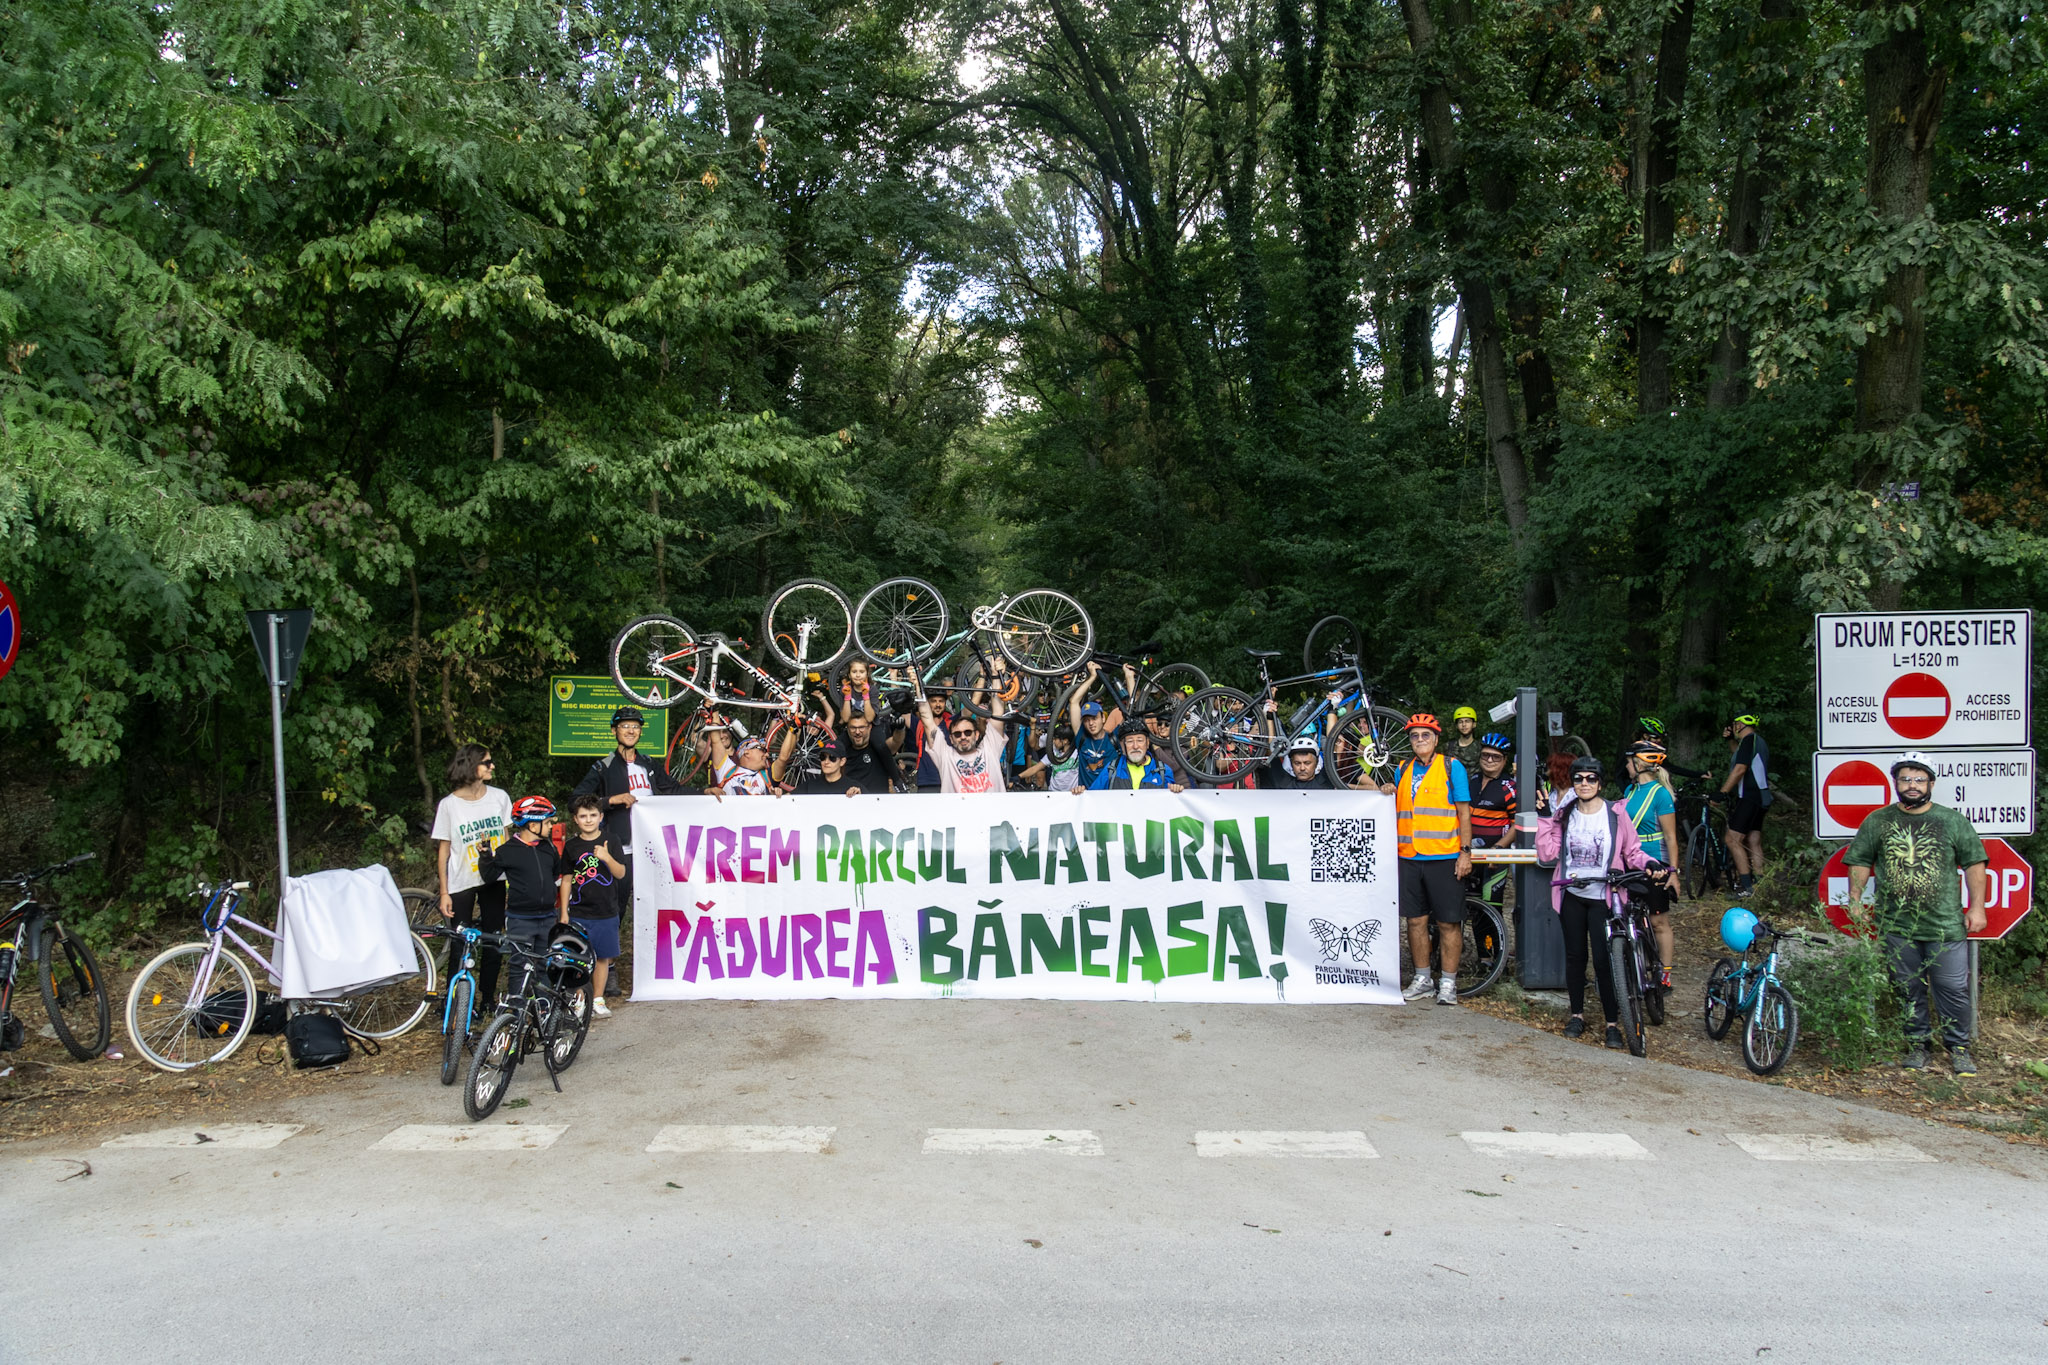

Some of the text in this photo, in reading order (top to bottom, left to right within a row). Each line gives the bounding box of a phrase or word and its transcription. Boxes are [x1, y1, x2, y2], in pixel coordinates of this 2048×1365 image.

[1835, 620, 2017, 647] DRUM FORESTIER
[1893, 653, 1959, 667] L=1520 m
[1827, 696, 1878, 707] ACCESUL
[1966, 694, 2011, 705] ACCESS
[1828, 712, 1877, 723] INTERZIS
[1955, 709, 2021, 721] PROHIBITED
[1956, 763, 1970, 777] CU
[1973, 762, 2028, 776] RESTRICTII
[1955, 785, 1965, 802] SI
[1999, 806, 2026, 823] SENS
[661, 816, 1290, 885] VREM PARCUL NATURAL
[655, 899, 1289, 987] PĂDUREA BĂNEASA!
[1315, 965, 1379, 978] PARCUL NATURAL
[1315, 973, 1381, 987] BUCUREȘTI
